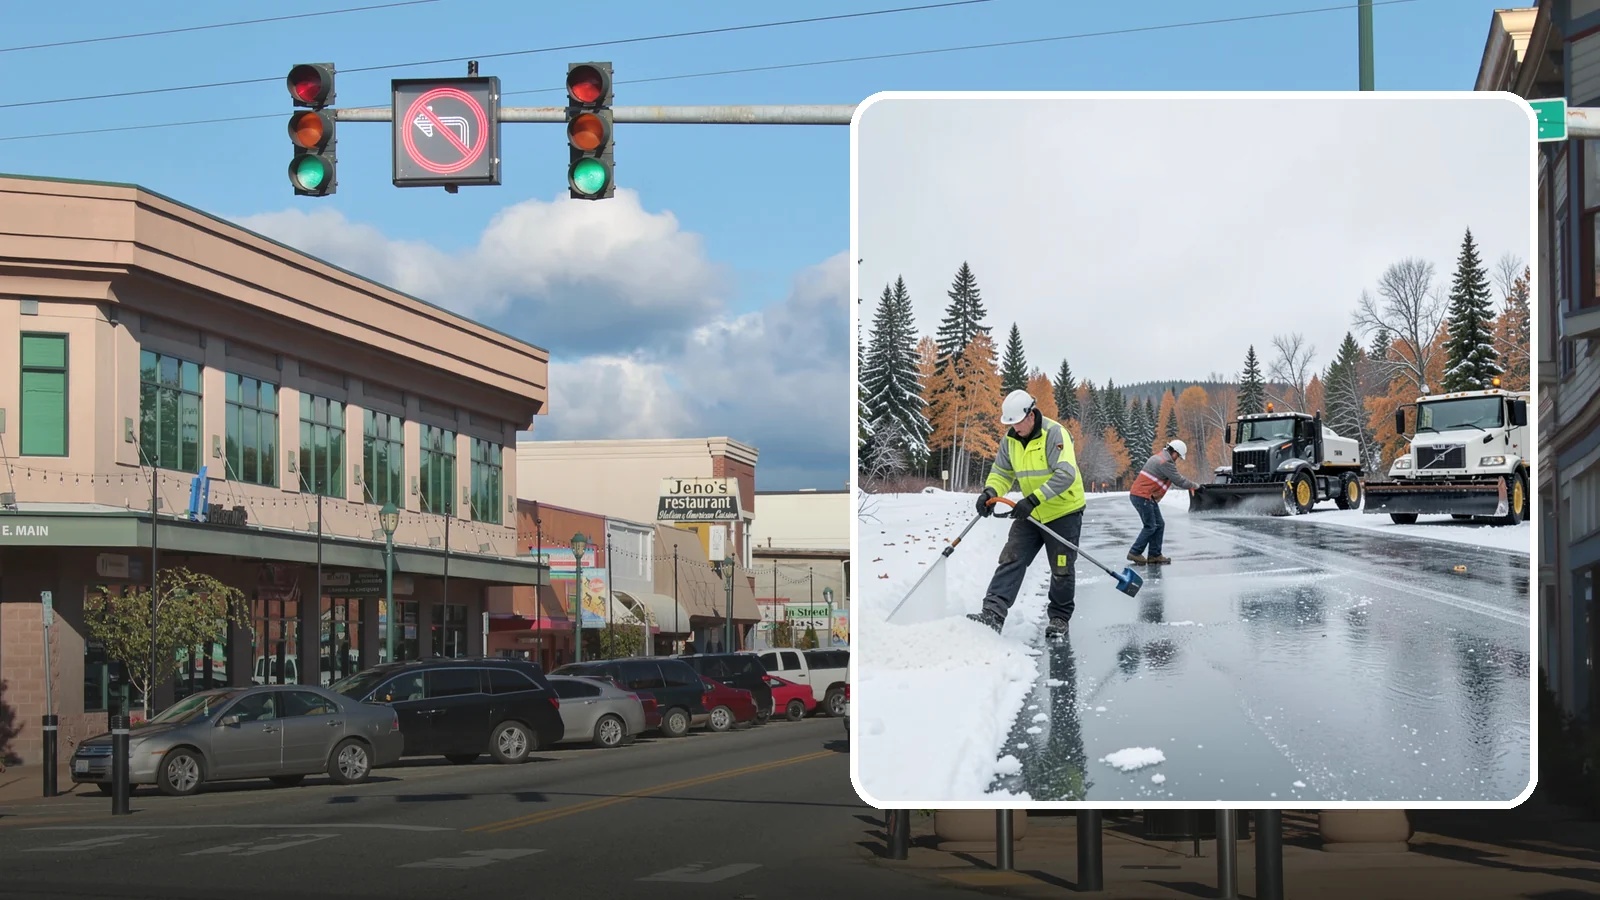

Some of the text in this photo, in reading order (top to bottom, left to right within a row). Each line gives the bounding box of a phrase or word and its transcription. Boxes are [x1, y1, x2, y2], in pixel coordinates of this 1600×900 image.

[669, 479, 728, 494] Jeno's
[665, 496, 731, 509] restaurant
[658, 511, 682, 520] Italian
[686, 510, 715, 519] American
[715, 509, 738, 519] Cuisine
[2, 525, 49, 536] E. MAIN
[797, 607, 829, 617] Street
